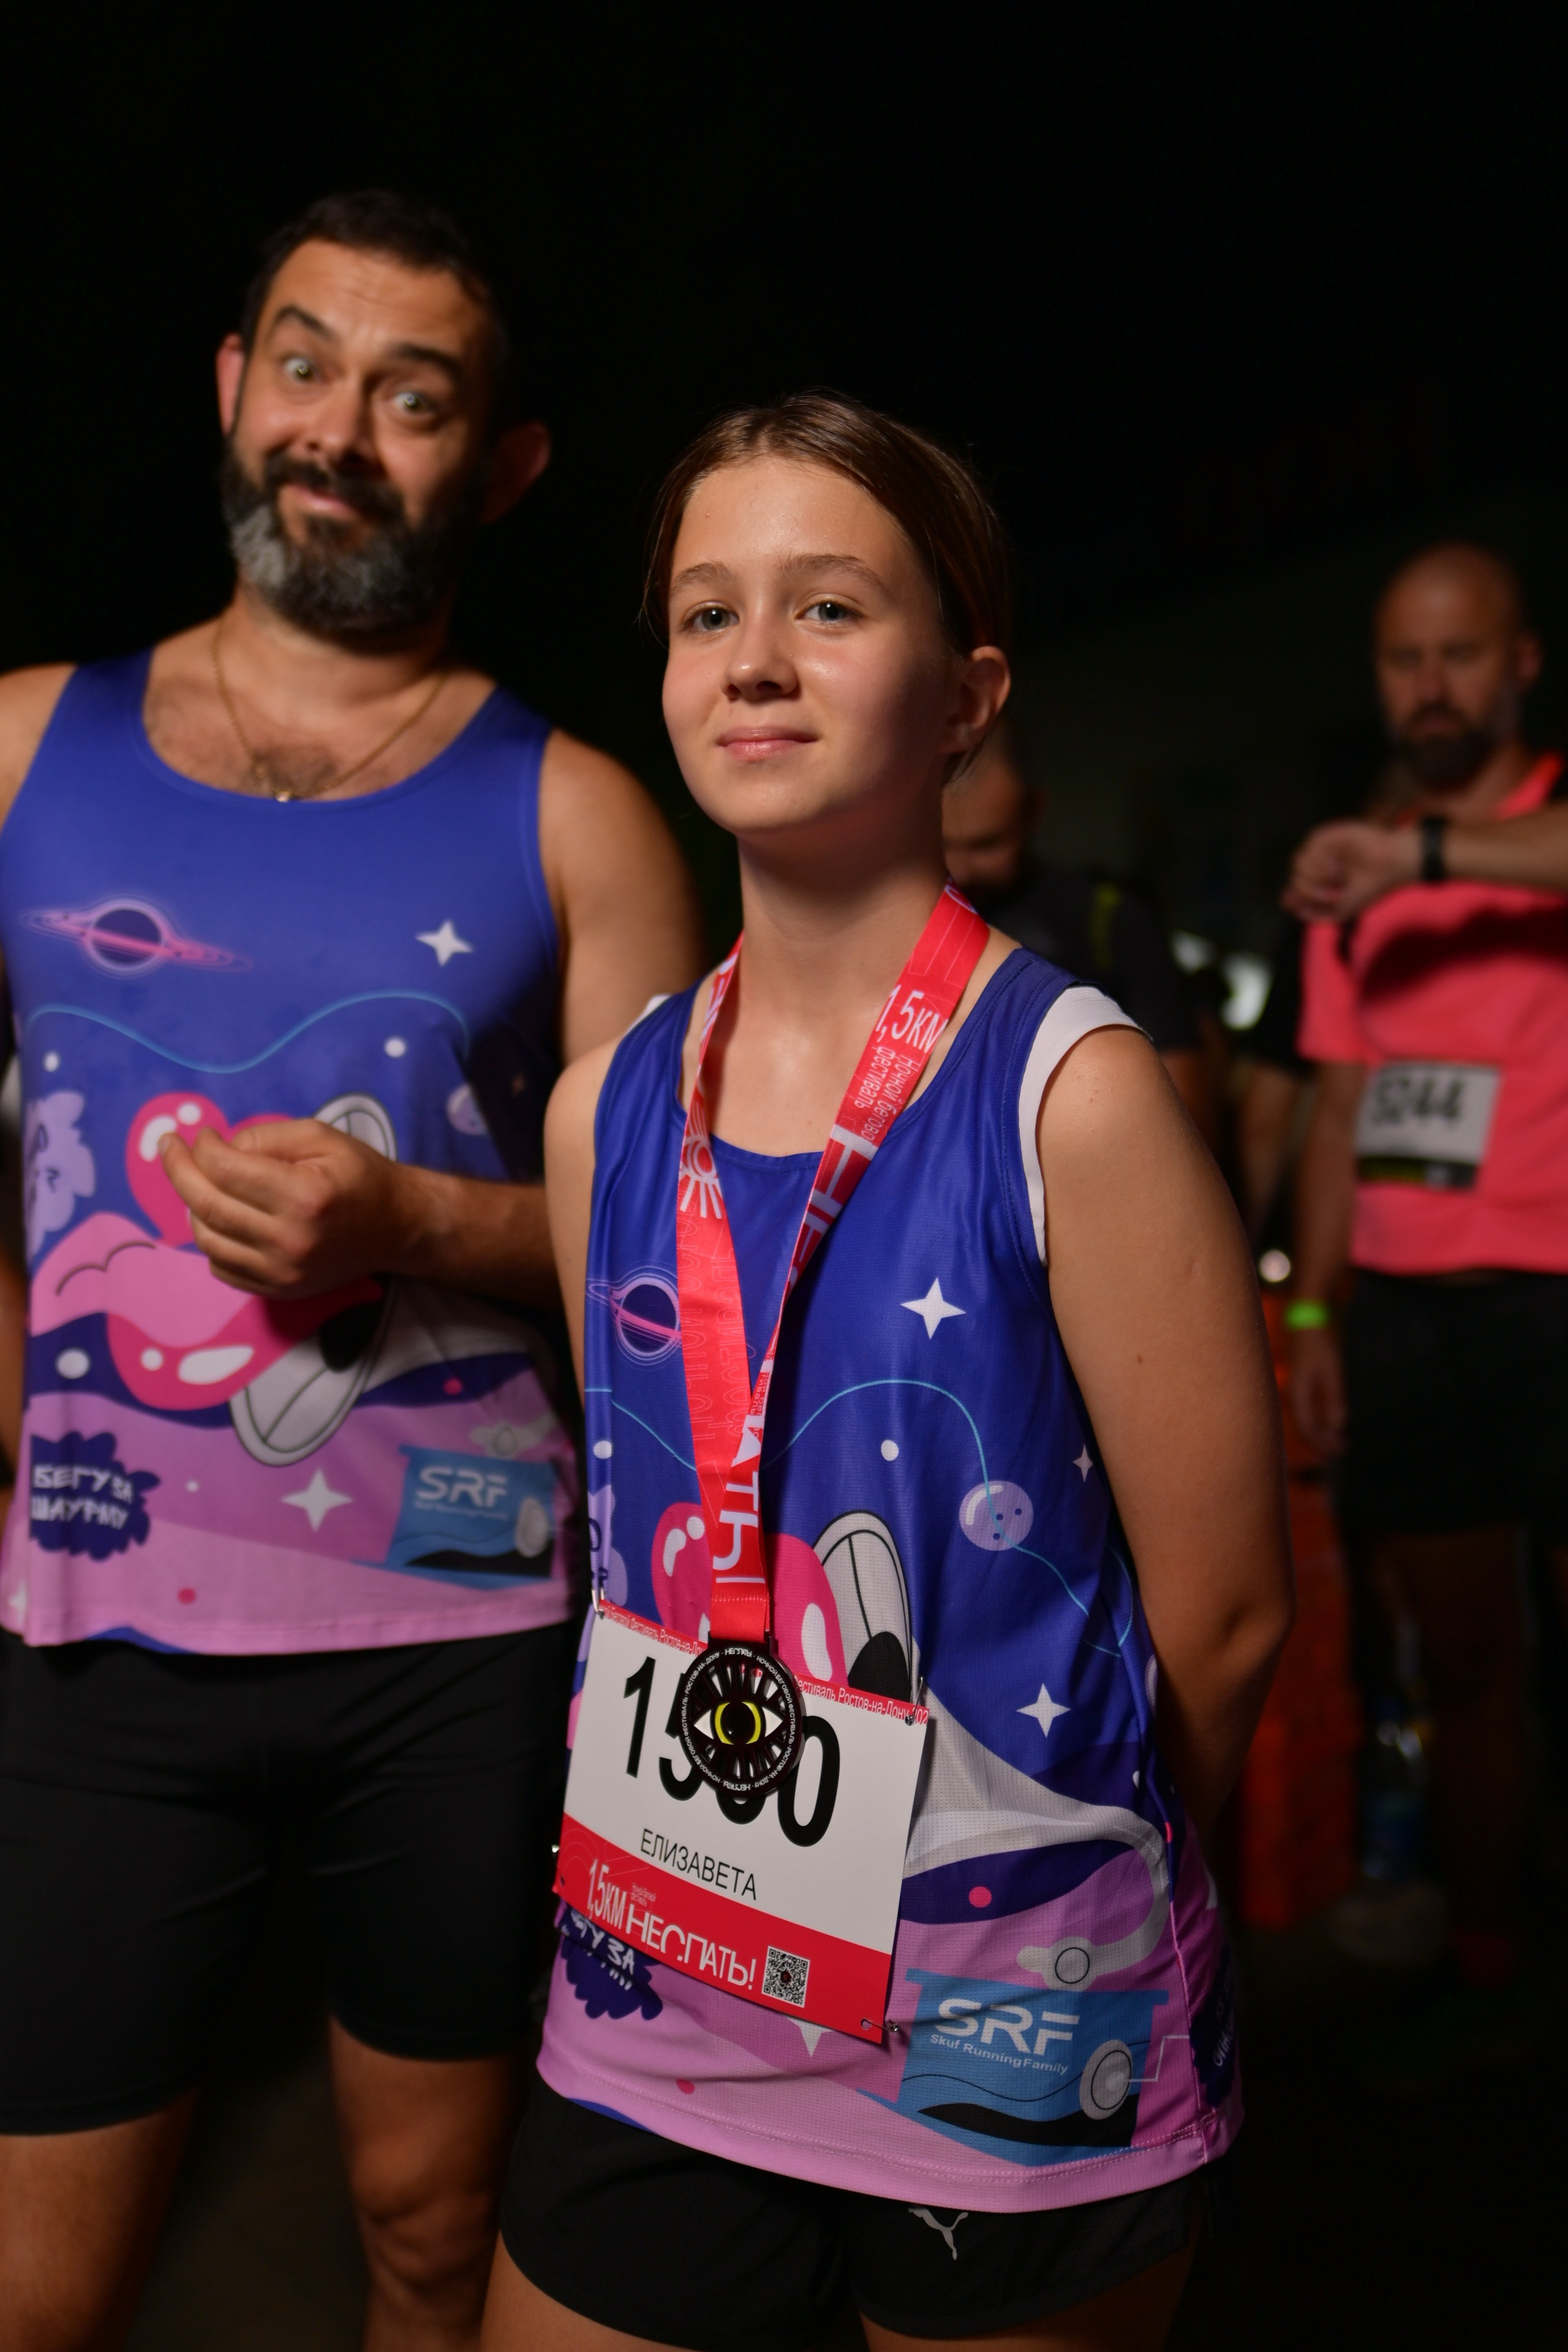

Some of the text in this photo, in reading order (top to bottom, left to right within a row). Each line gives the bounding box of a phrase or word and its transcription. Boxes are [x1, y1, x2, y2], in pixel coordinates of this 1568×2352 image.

[854, 1045, 900, 1109] фестиваль
[417, 1466, 508, 1507] SRF
[640, 1828, 756, 1901] ЕЛИЗАВЕТА
[930, 2034, 960, 2050] Skuf
[935, 1998, 1080, 2056] SRF
